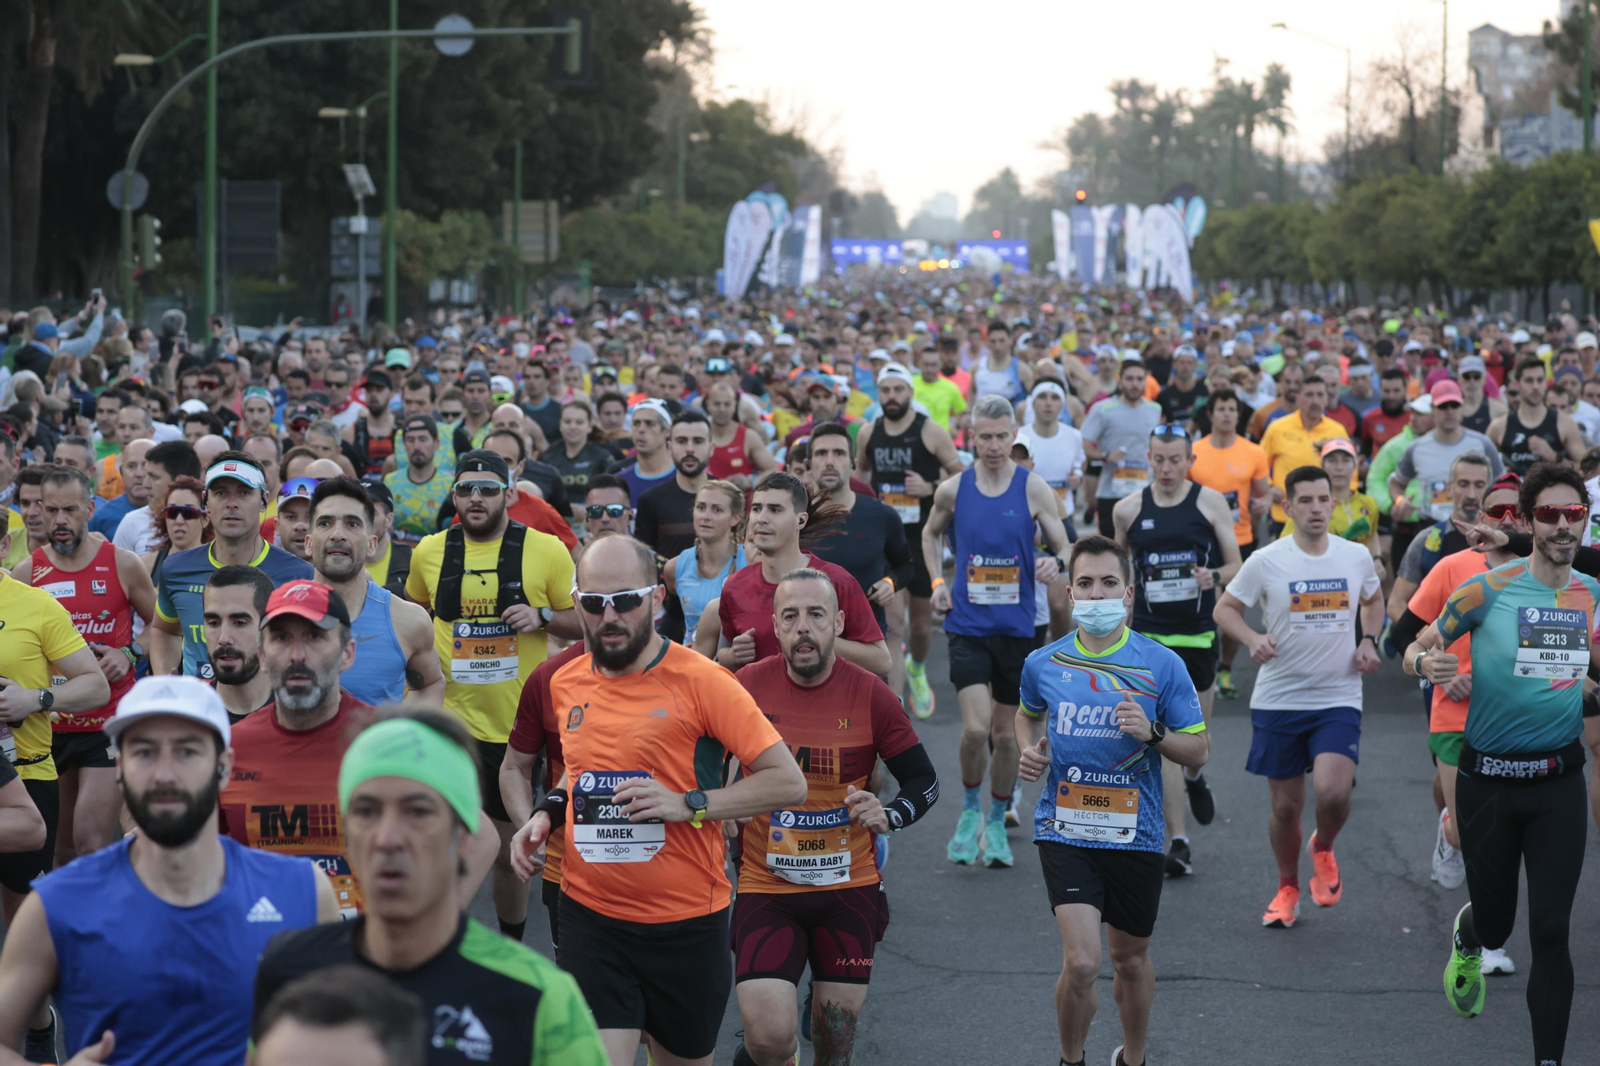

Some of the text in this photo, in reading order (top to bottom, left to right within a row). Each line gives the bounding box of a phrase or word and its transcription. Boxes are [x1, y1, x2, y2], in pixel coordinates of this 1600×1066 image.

[874, 447, 912, 465] RUN
[984, 556, 1015, 566] ZURICH
[1160, 552, 1192, 563] ZURICH
[1308, 581, 1342, 591] ZURICH
[70, 611, 92, 620] nicas
[1304, 612, 1337, 620] MATTHEW
[1542, 611, 1580, 623] ZURICH
[75, 618, 116, 634] alud
[472, 625, 509, 636] ZURICH
[1543, 633, 1567, 645] 3213
[473, 645, 496, 655] 4342
[1539, 651, 1570, 661] KBD-10
[469, 660, 501, 670] GONCHO
[1480, 765, 1537, 778] SPORT
[1083, 772, 1130, 784] ZURICH
[1082, 795, 1110, 808] 5665
[797, 813, 841, 826] ZURICH
[596, 828, 634, 839] MAREK
[797, 839, 826, 851] 5068
[774, 855, 845, 868] MALUMA BABY
